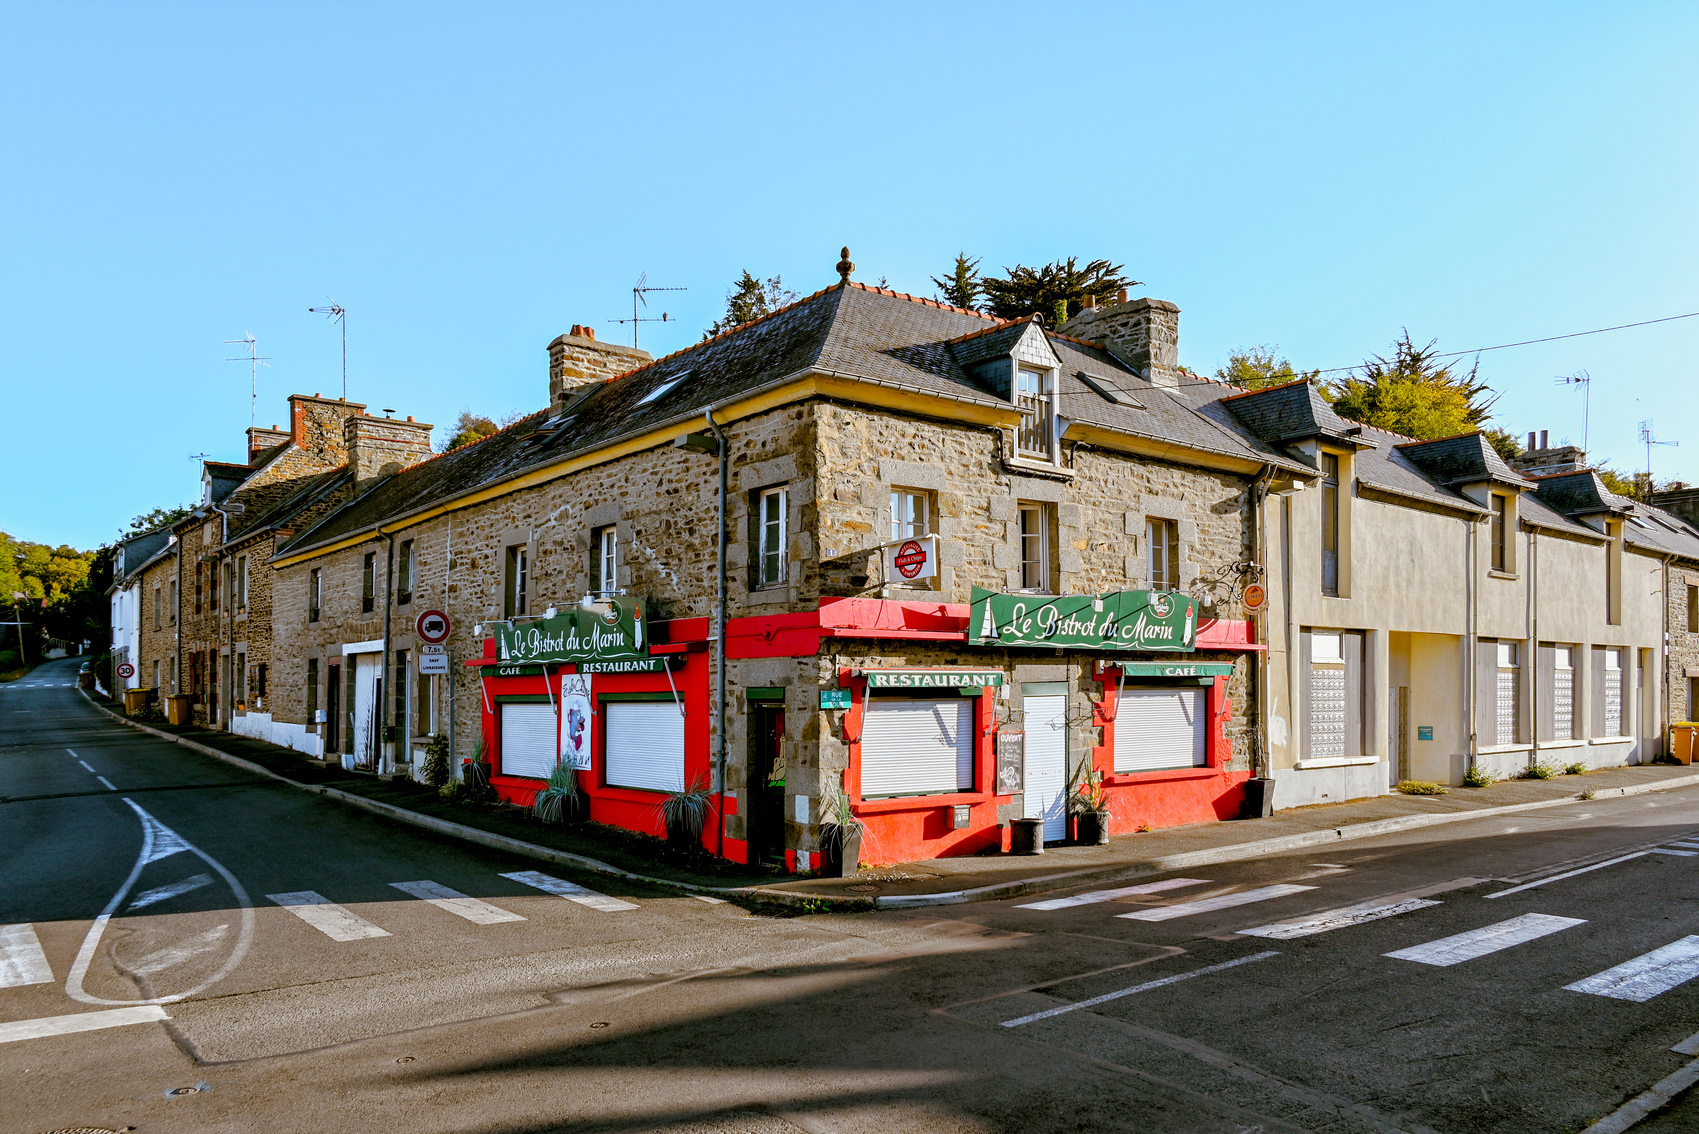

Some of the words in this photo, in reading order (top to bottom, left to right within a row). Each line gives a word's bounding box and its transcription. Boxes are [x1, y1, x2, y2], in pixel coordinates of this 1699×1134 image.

[1002, 602, 1032, 638] Le
[1034, 604, 1096, 640] Bistrot
[1099, 612, 1118, 640] du
[1122, 612, 1173, 643] Marin
[511, 630, 526, 657] Le
[528, 628, 564, 658] Bistrot
[566, 626, 580, 650] du
[583, 622, 624, 652] Marin
[583, 660, 655, 673] RESTAURANT
[1165, 666, 1197, 676] CAFÉ
[876, 674, 996, 686] RESTAURANT
[1001, 733, 1022, 742] OUVERT
